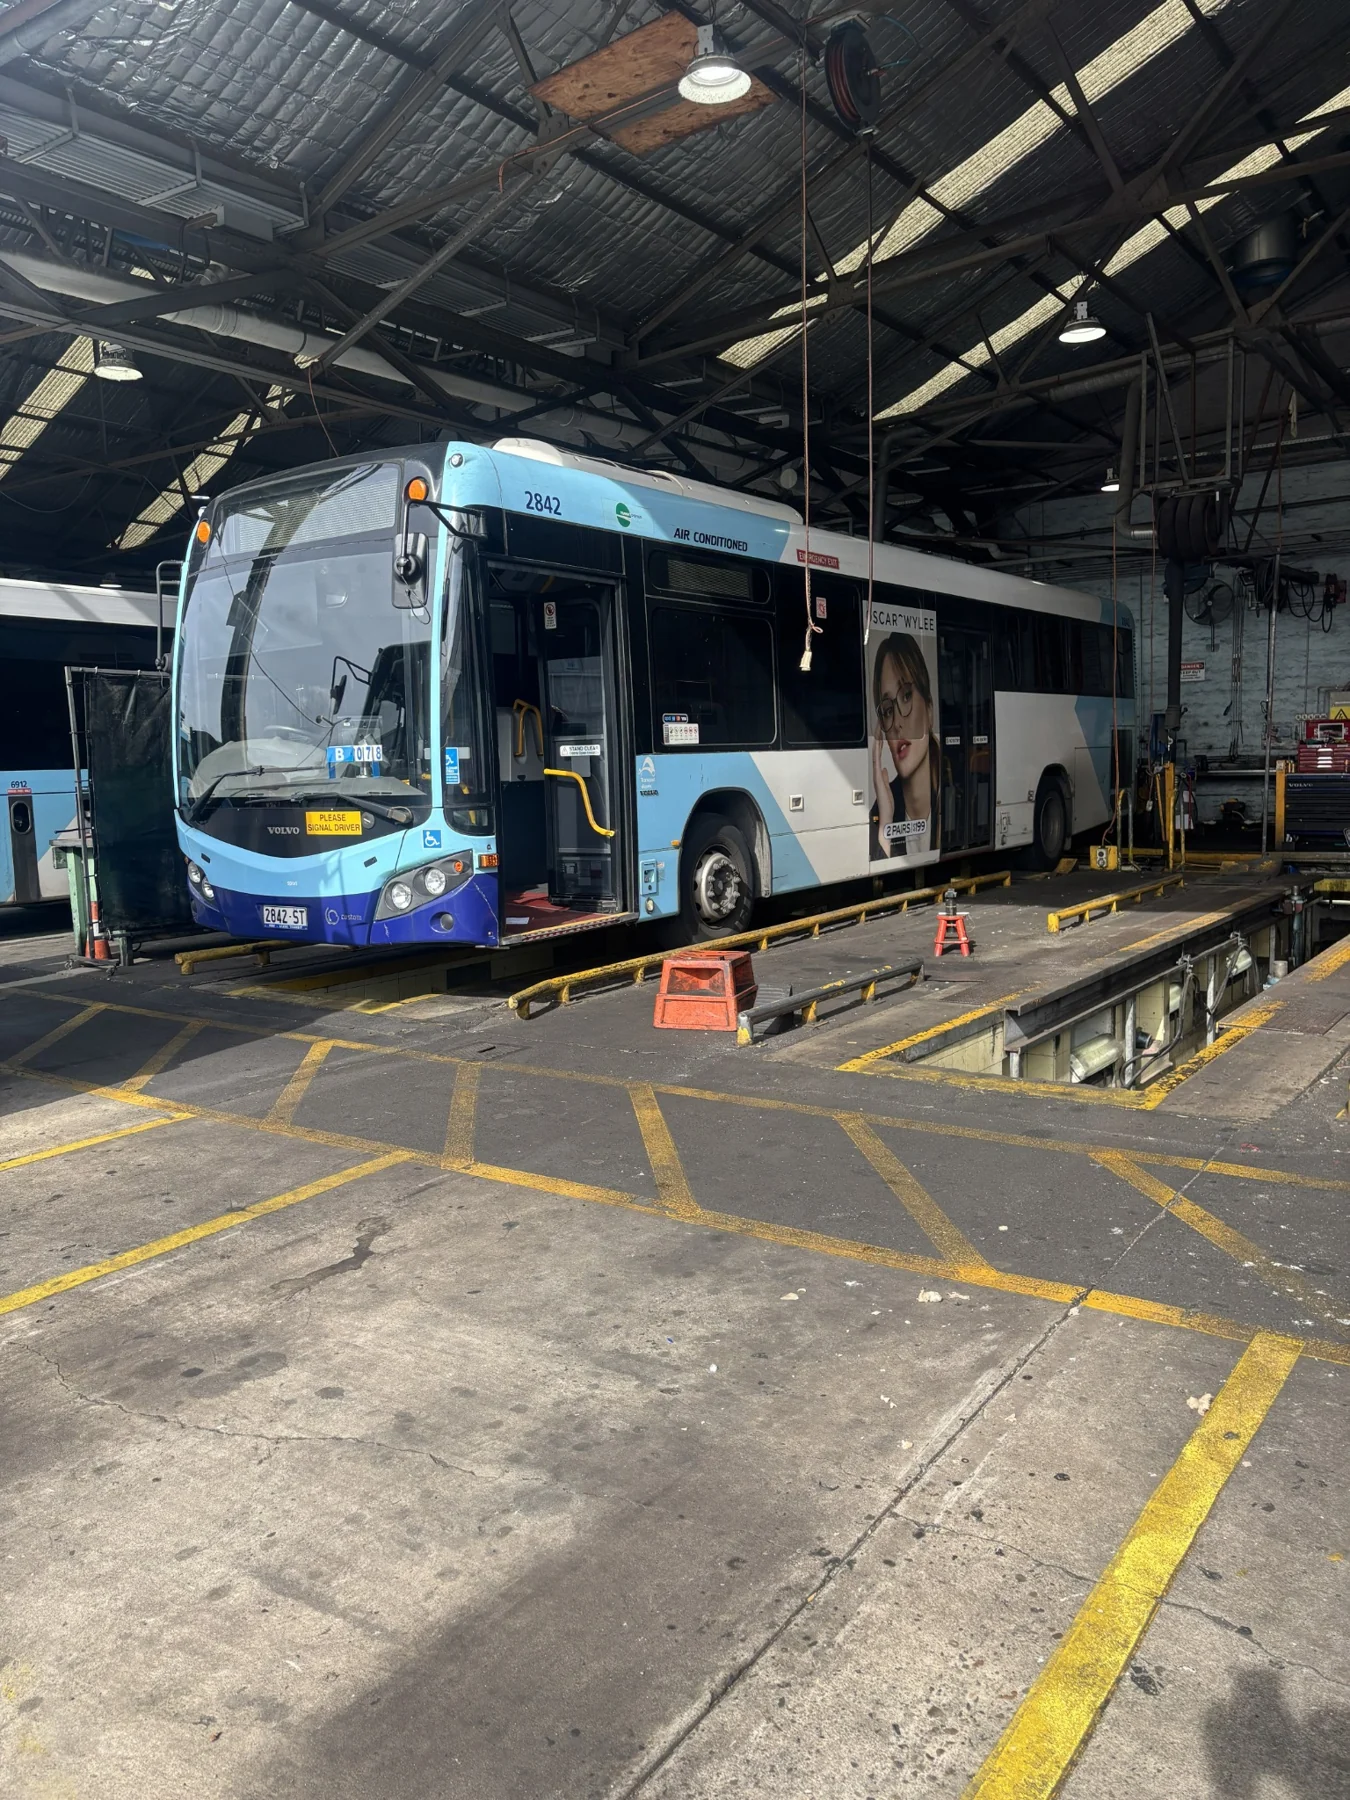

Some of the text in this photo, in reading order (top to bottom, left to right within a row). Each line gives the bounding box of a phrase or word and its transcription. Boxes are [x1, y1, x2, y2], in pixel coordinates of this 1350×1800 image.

[525, 491, 562, 516] 2842
[674, 528, 748, 552] AIR CONDITIONED
[799, 552, 837, 568] ERGENCY EXIT
[866, 610, 898, 627] SCAR
[335, 748, 344, 761] B
[11, 780, 28, 788] 6912
[320, 814, 346, 822] PLEASE
[267, 826, 300, 834] VOLVO
[308, 824, 360, 832] SIGNAL DRIVER
[886, 826, 891, 837] 2
[892, 823, 911, 835] PAIRS
